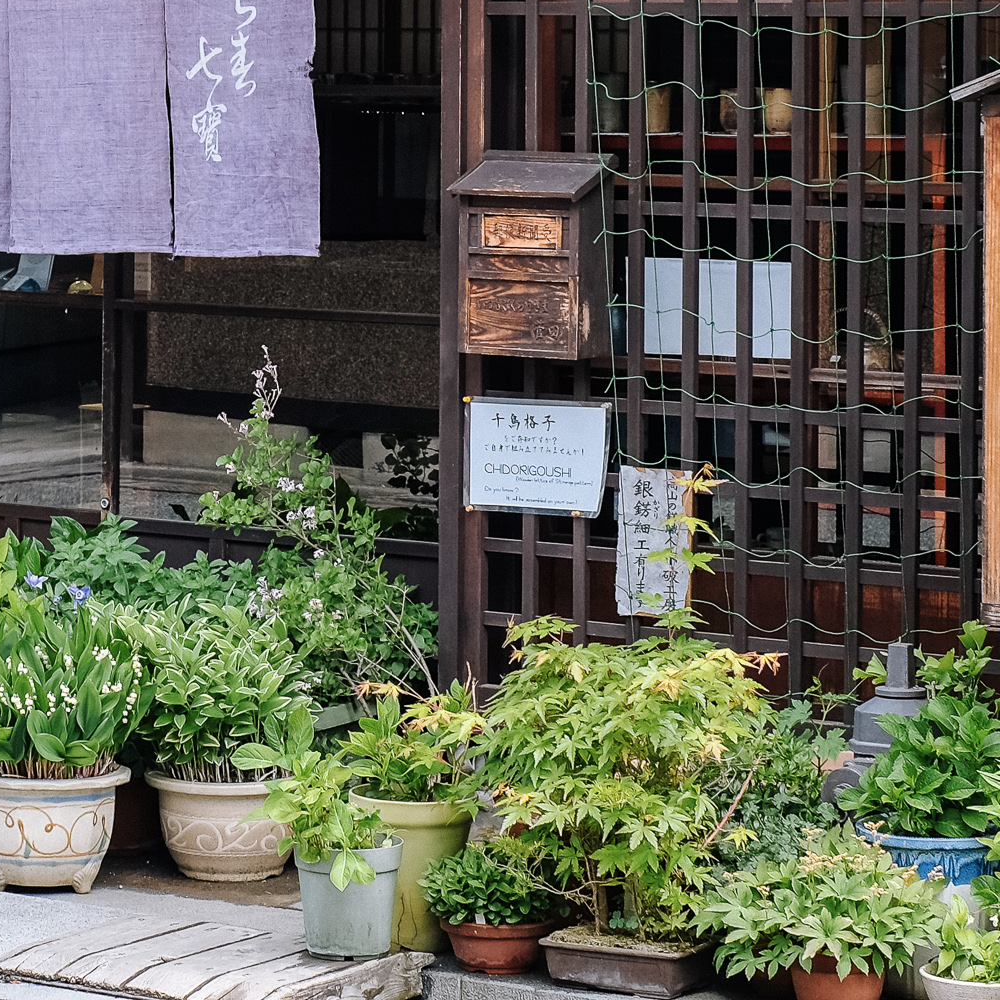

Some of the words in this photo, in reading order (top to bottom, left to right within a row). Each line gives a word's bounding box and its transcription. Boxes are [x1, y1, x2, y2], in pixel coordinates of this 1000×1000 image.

[491, 413, 556, 431] 千鳥格子
[484, 463, 572, 478] CHIDORIGOUSHI
